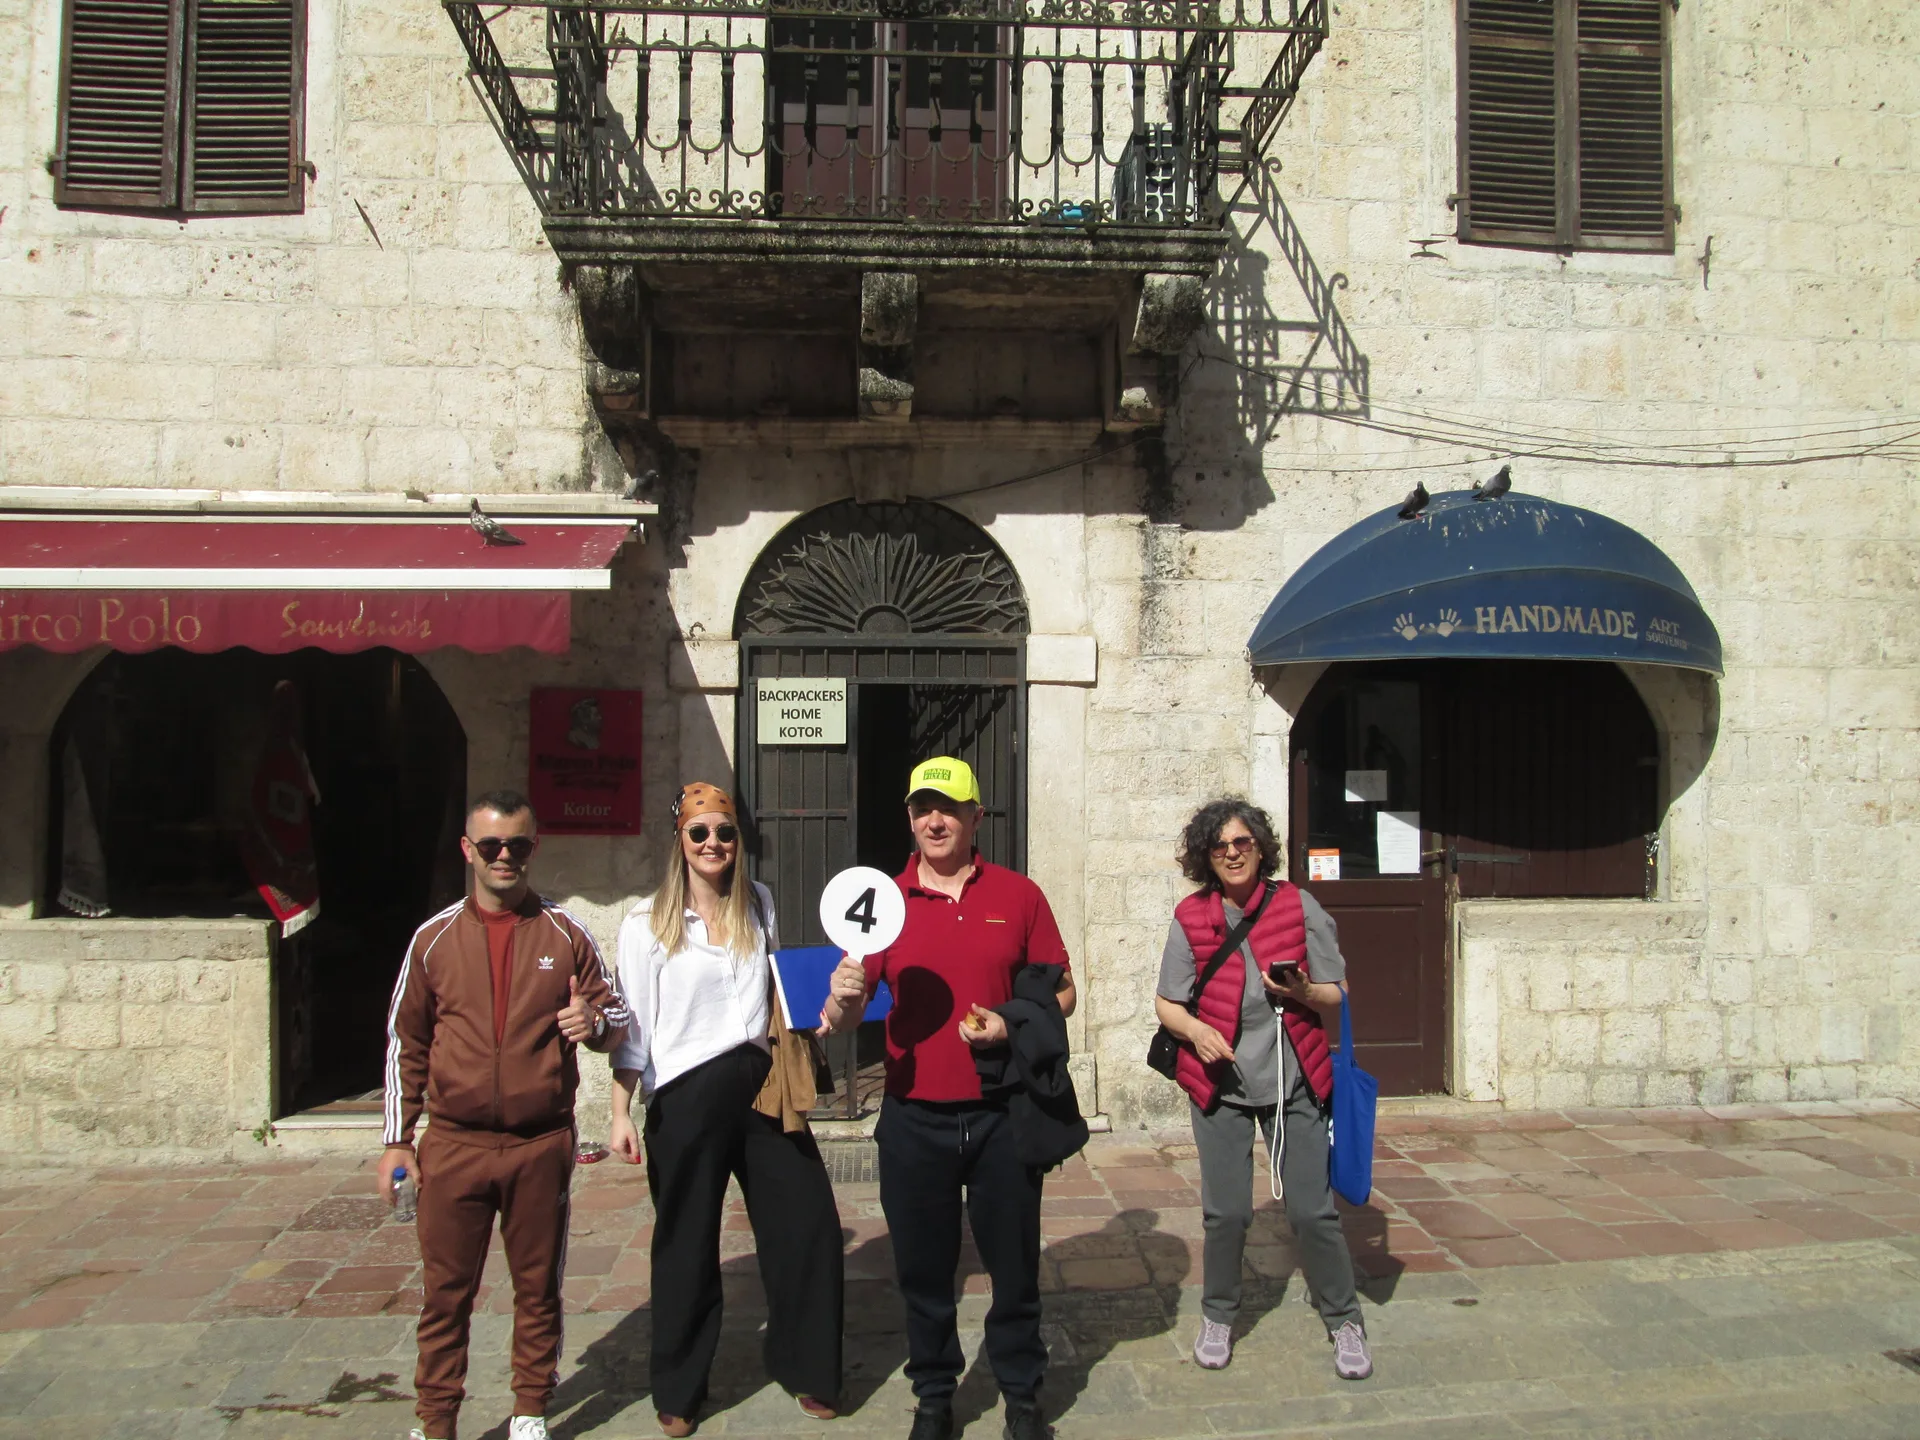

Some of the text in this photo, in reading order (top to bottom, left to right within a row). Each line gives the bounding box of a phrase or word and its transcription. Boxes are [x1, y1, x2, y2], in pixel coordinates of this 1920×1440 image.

[0, 597, 201, 642] rco Polo
[1474, 605, 1638, 640] HANDMADE
[1649, 616, 1680, 636] ART
[759, 690, 844, 702] BACKPACKERS
[781, 708, 822, 720] HOME
[779, 726, 823, 738] KOTOR
[563, 801, 612, 817] Kotor
[844, 887, 878, 934] 4
